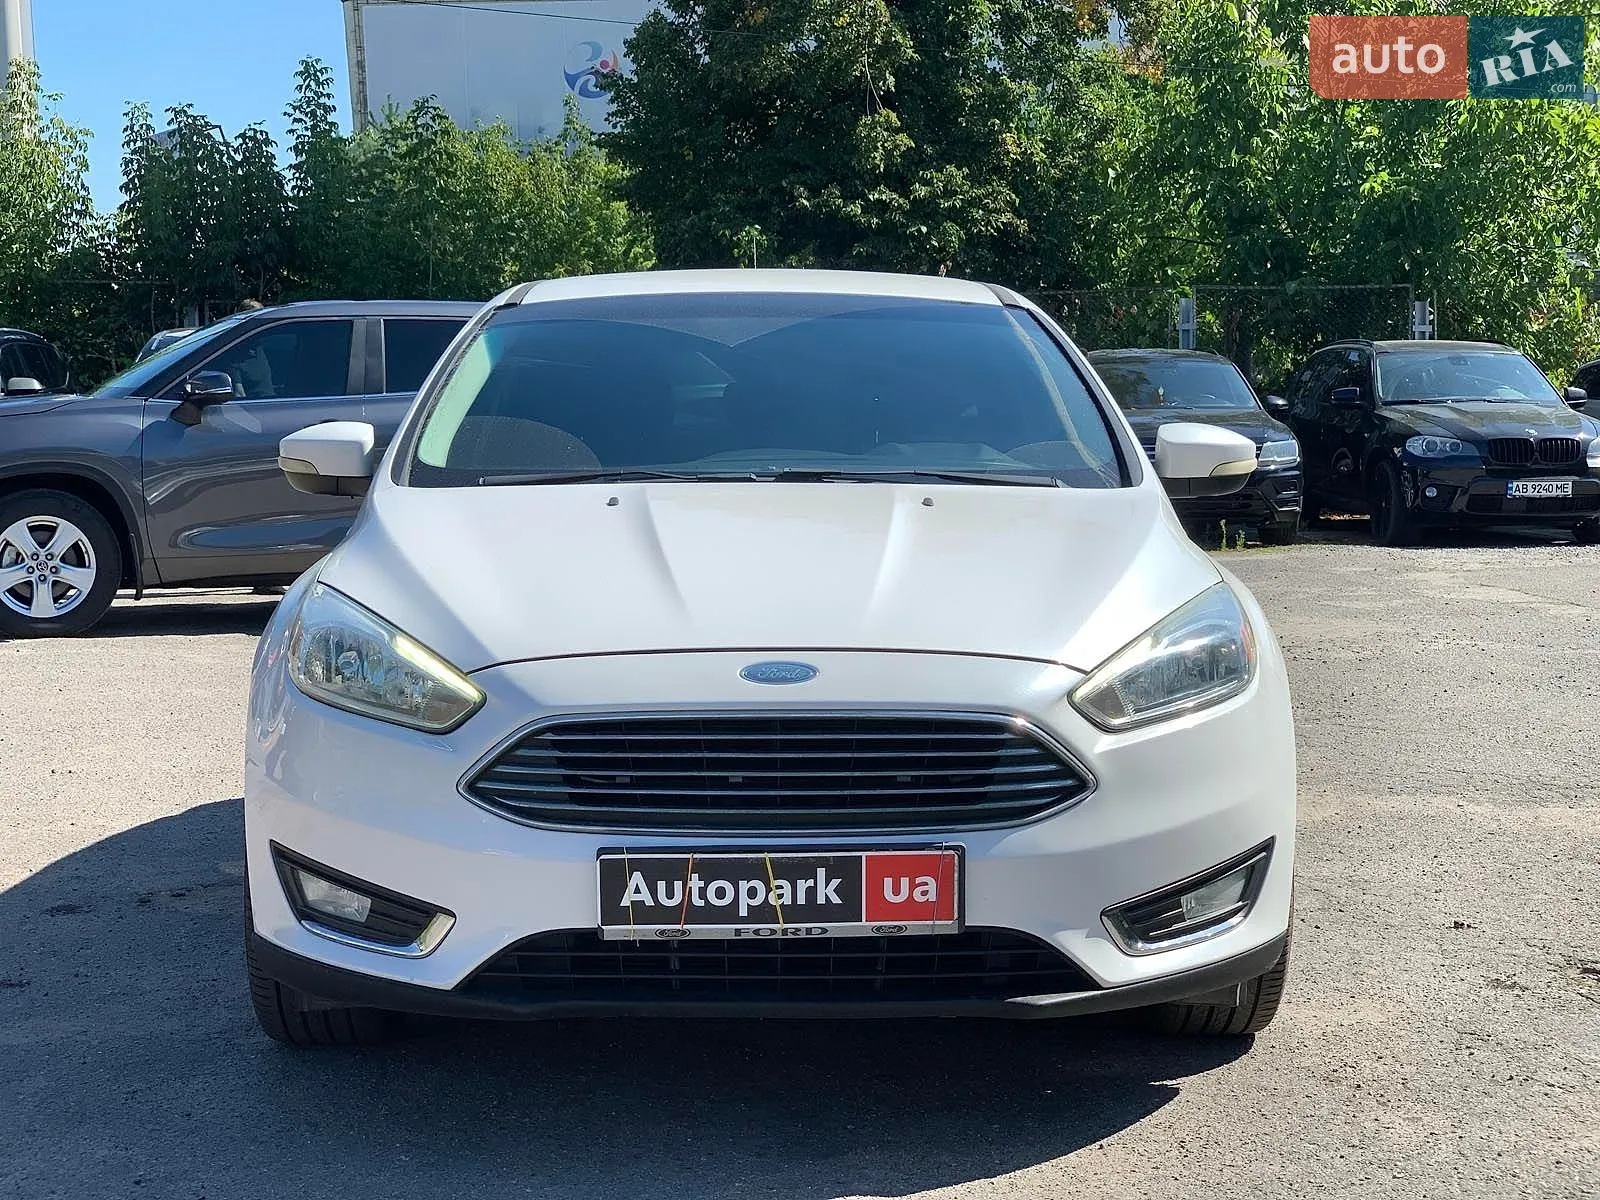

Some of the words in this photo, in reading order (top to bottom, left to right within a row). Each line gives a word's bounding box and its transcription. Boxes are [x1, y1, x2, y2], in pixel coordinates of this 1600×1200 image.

[1513, 483, 1529, 494] AB
[1531, 483, 1554, 494] 9240
[1555, 483, 1570, 494] ME
[758, 665, 802, 681] Ford
[619, 867, 843, 917] Autopark
[883, 875, 937, 904] ua
[733, 926, 829, 938] FORD
